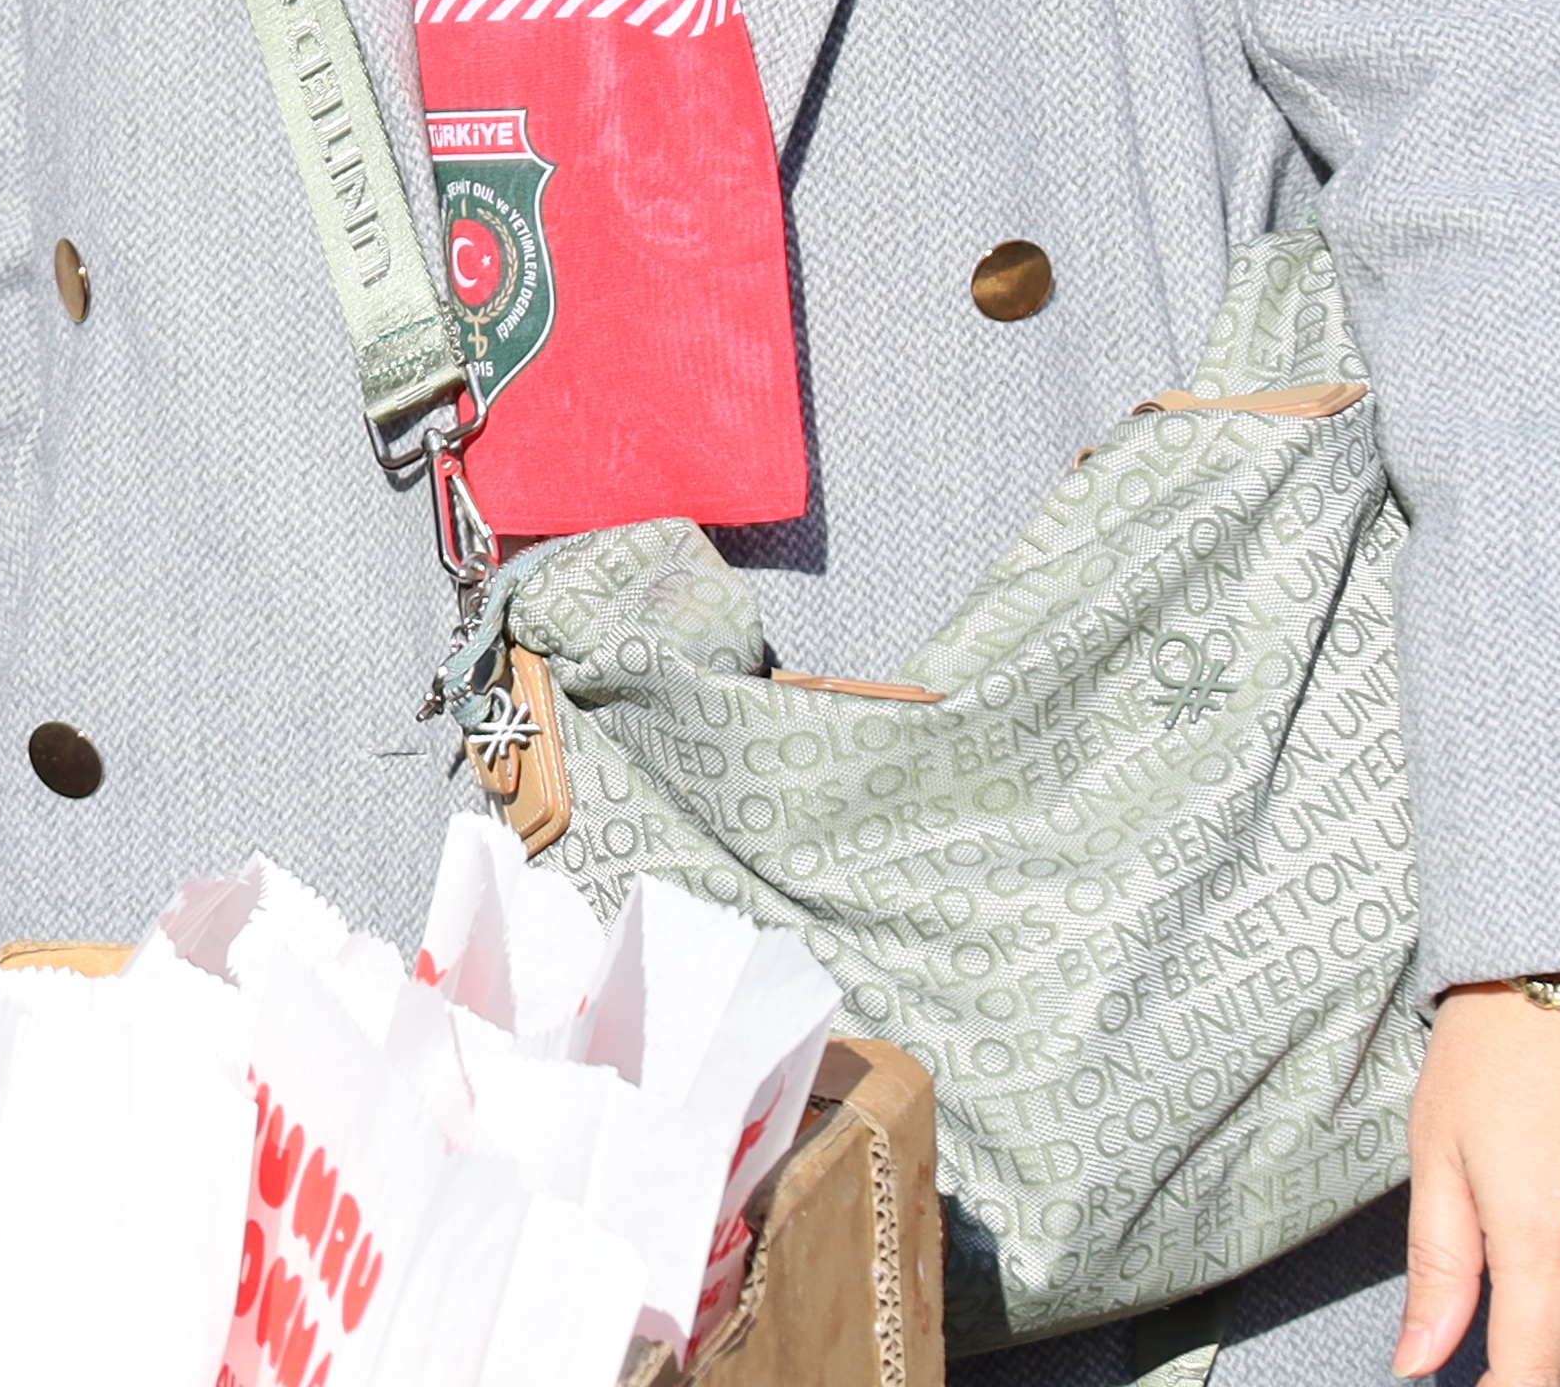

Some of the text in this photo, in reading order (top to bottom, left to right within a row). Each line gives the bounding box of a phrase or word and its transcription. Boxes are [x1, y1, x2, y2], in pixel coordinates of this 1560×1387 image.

[494, 287, 535, 344] DERNEĞİ
[862, 750, 936, 801] OF
[973, 761, 1045, 815] OF
[975, 969, 1049, 1023] OF
[1272, 729, 1407, 853] UNITED
[1064, 859, 1137, 917] OF
[1096, 972, 1152, 1036] OF
[1161, 837, 1382, 1001] BENETTON.
[1157, 944, 1323, 1063] UNITED
